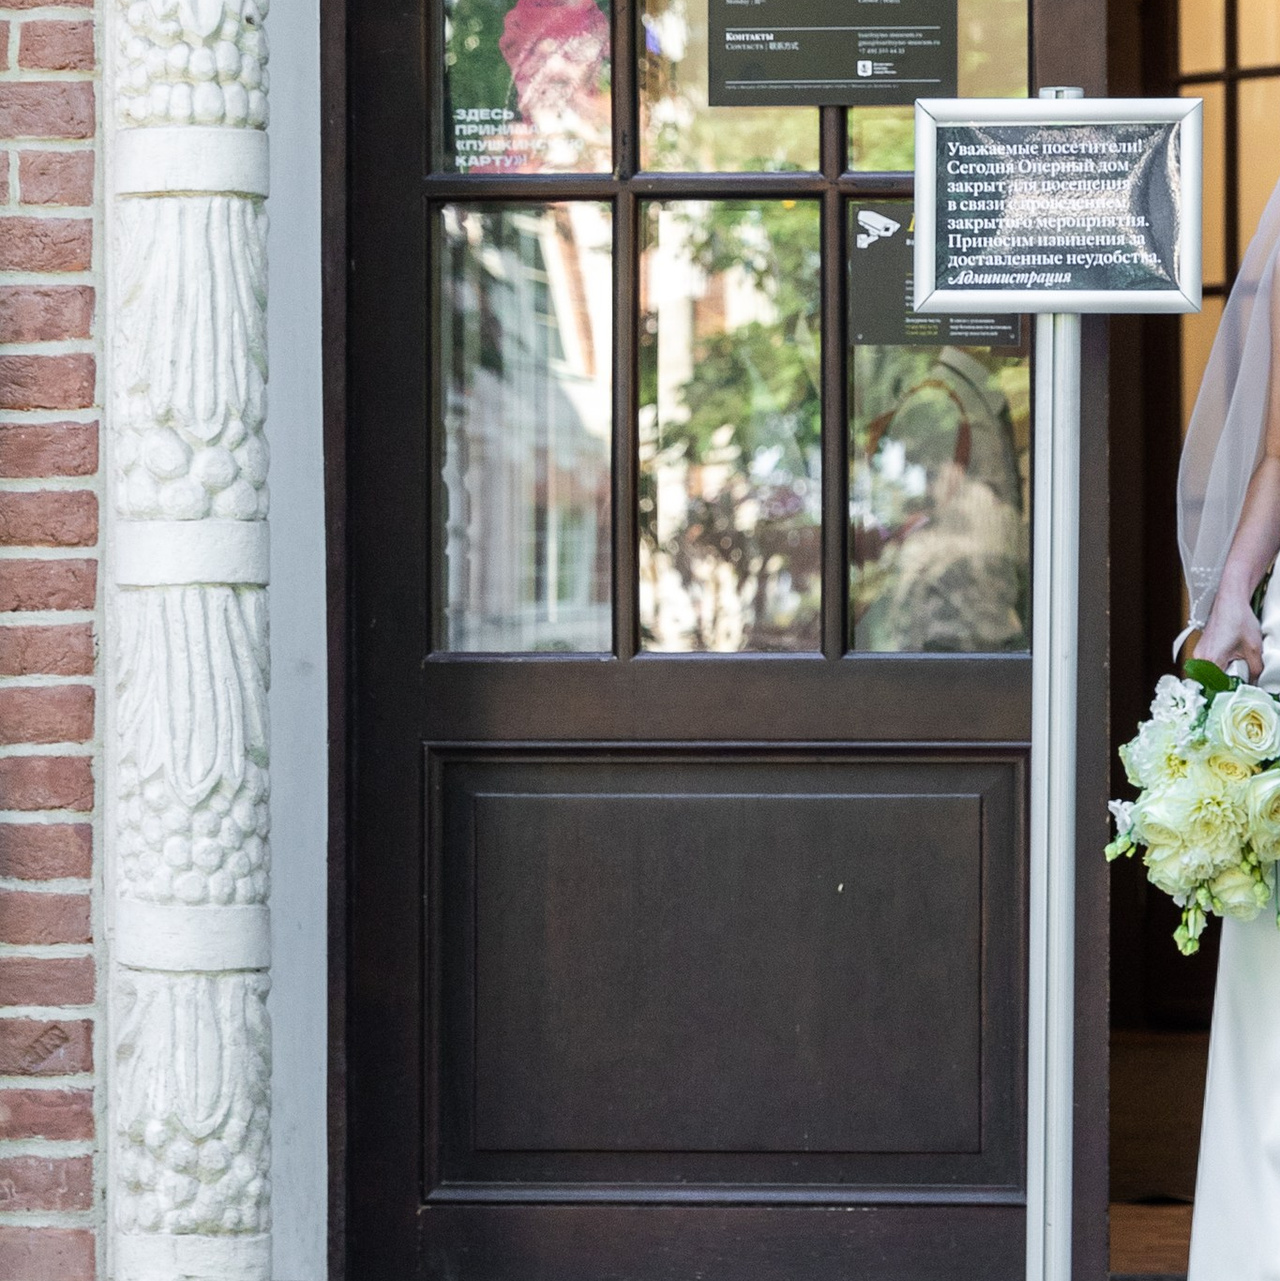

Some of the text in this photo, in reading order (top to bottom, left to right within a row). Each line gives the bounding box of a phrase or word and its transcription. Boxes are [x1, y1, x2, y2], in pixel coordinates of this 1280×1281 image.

[455, 108, 515, 122] ЗДЕСЬ
[947, 138, 1143, 156] Уважаемые посетители!
[947, 158, 1130, 176] Сегодня Оперный дом
[947, 179, 1006, 197] закрыт
[1041, 178, 1131, 193] посещения
[947, 200, 957, 211] в
[960, 199, 1005, 211] связи
[947, 215, 1150, 234] закрытого мероприятия.
[947, 233, 1146, 252] Приносим извинения за
[947, 249, 1162, 269] доставленные неудобства.
[947, 269, 1072, 288] Администрация
